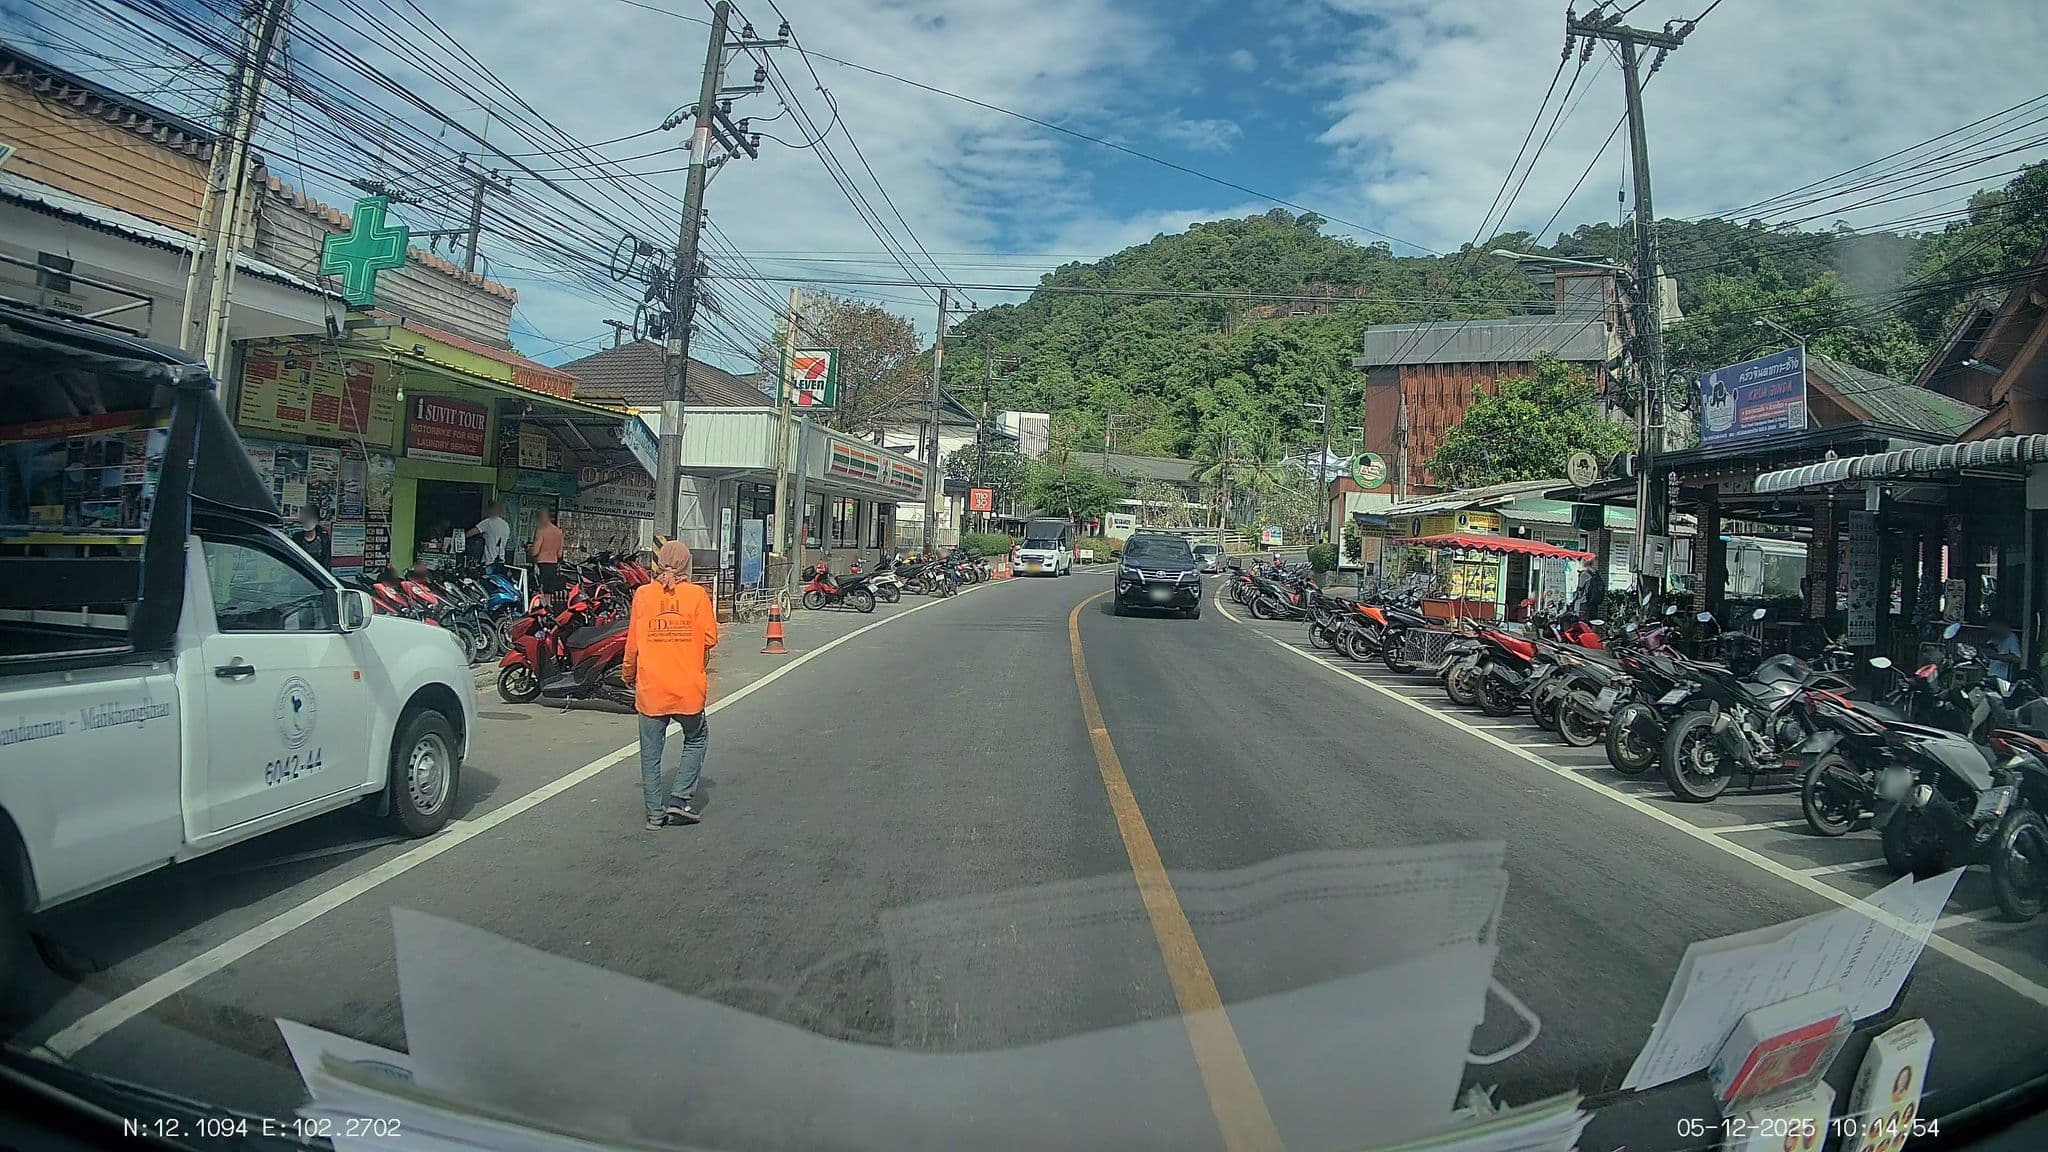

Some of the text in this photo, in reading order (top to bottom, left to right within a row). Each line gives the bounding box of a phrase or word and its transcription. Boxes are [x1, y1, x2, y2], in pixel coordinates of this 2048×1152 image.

[425, 404, 457, 425] SUVIT
[458, 410, 485, 430] TOUR
[410, 423, 484, 442] MOTORBIKE FOR RENT
[417, 438, 478, 453] LAUNDRY SERVICE
[583, 505, 621, 515] МОТОЦИКЛ
[628, 508, 655, 518] АРЕНДУ
[265, 748, 322, 787] 6042-44
